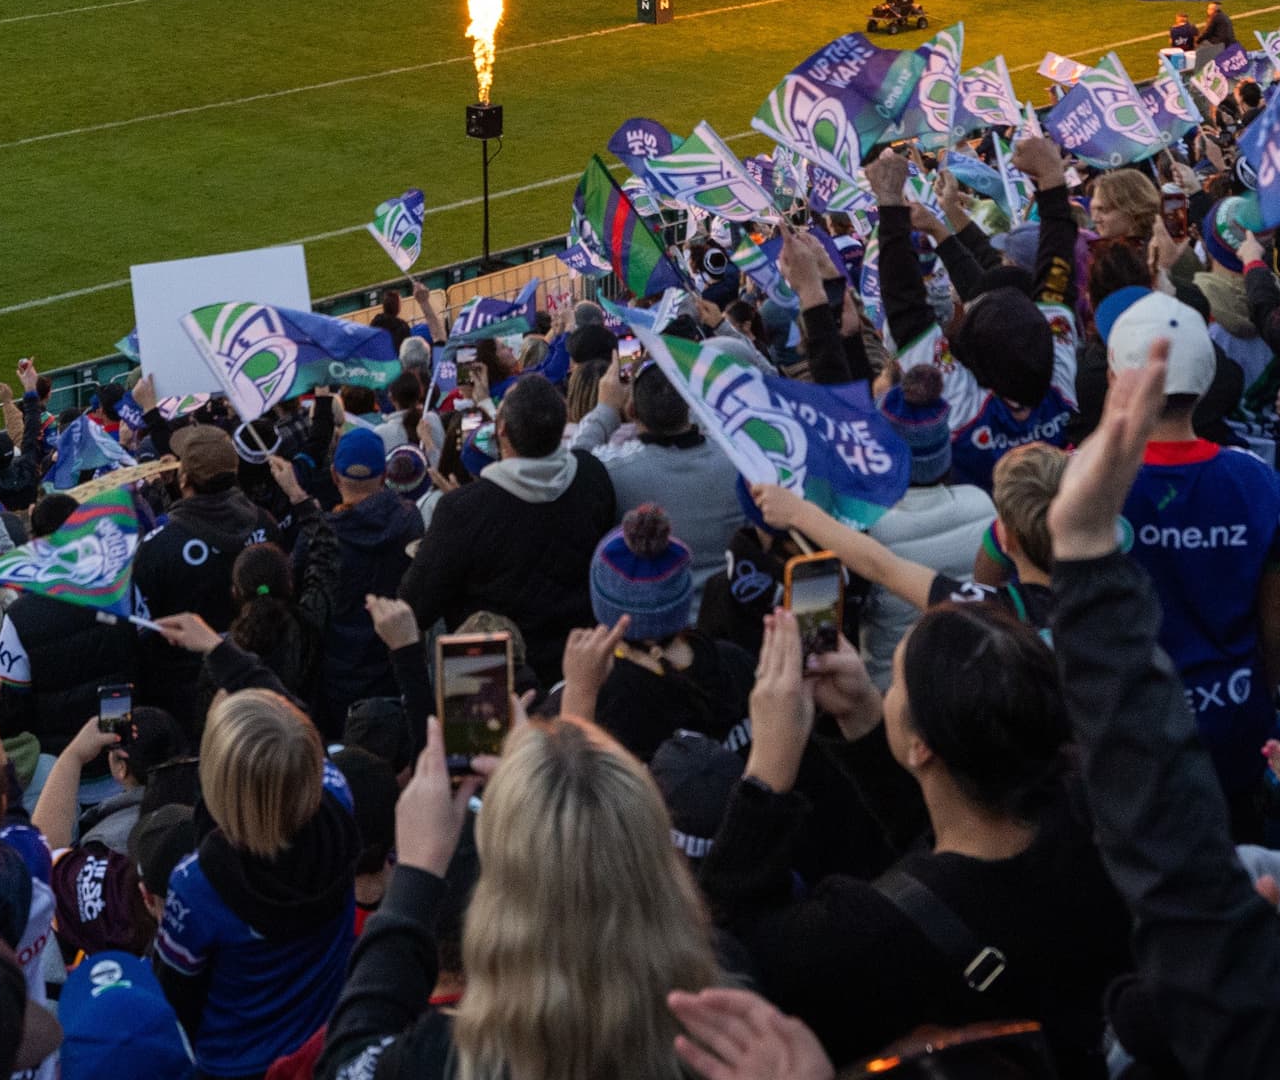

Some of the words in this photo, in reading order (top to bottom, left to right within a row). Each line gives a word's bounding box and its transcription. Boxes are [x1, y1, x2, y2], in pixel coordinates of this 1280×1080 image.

[807, 60, 831, 83] UP
[825, 33, 860, 65] THE
[1140, 525, 1247, 548] one.nz
